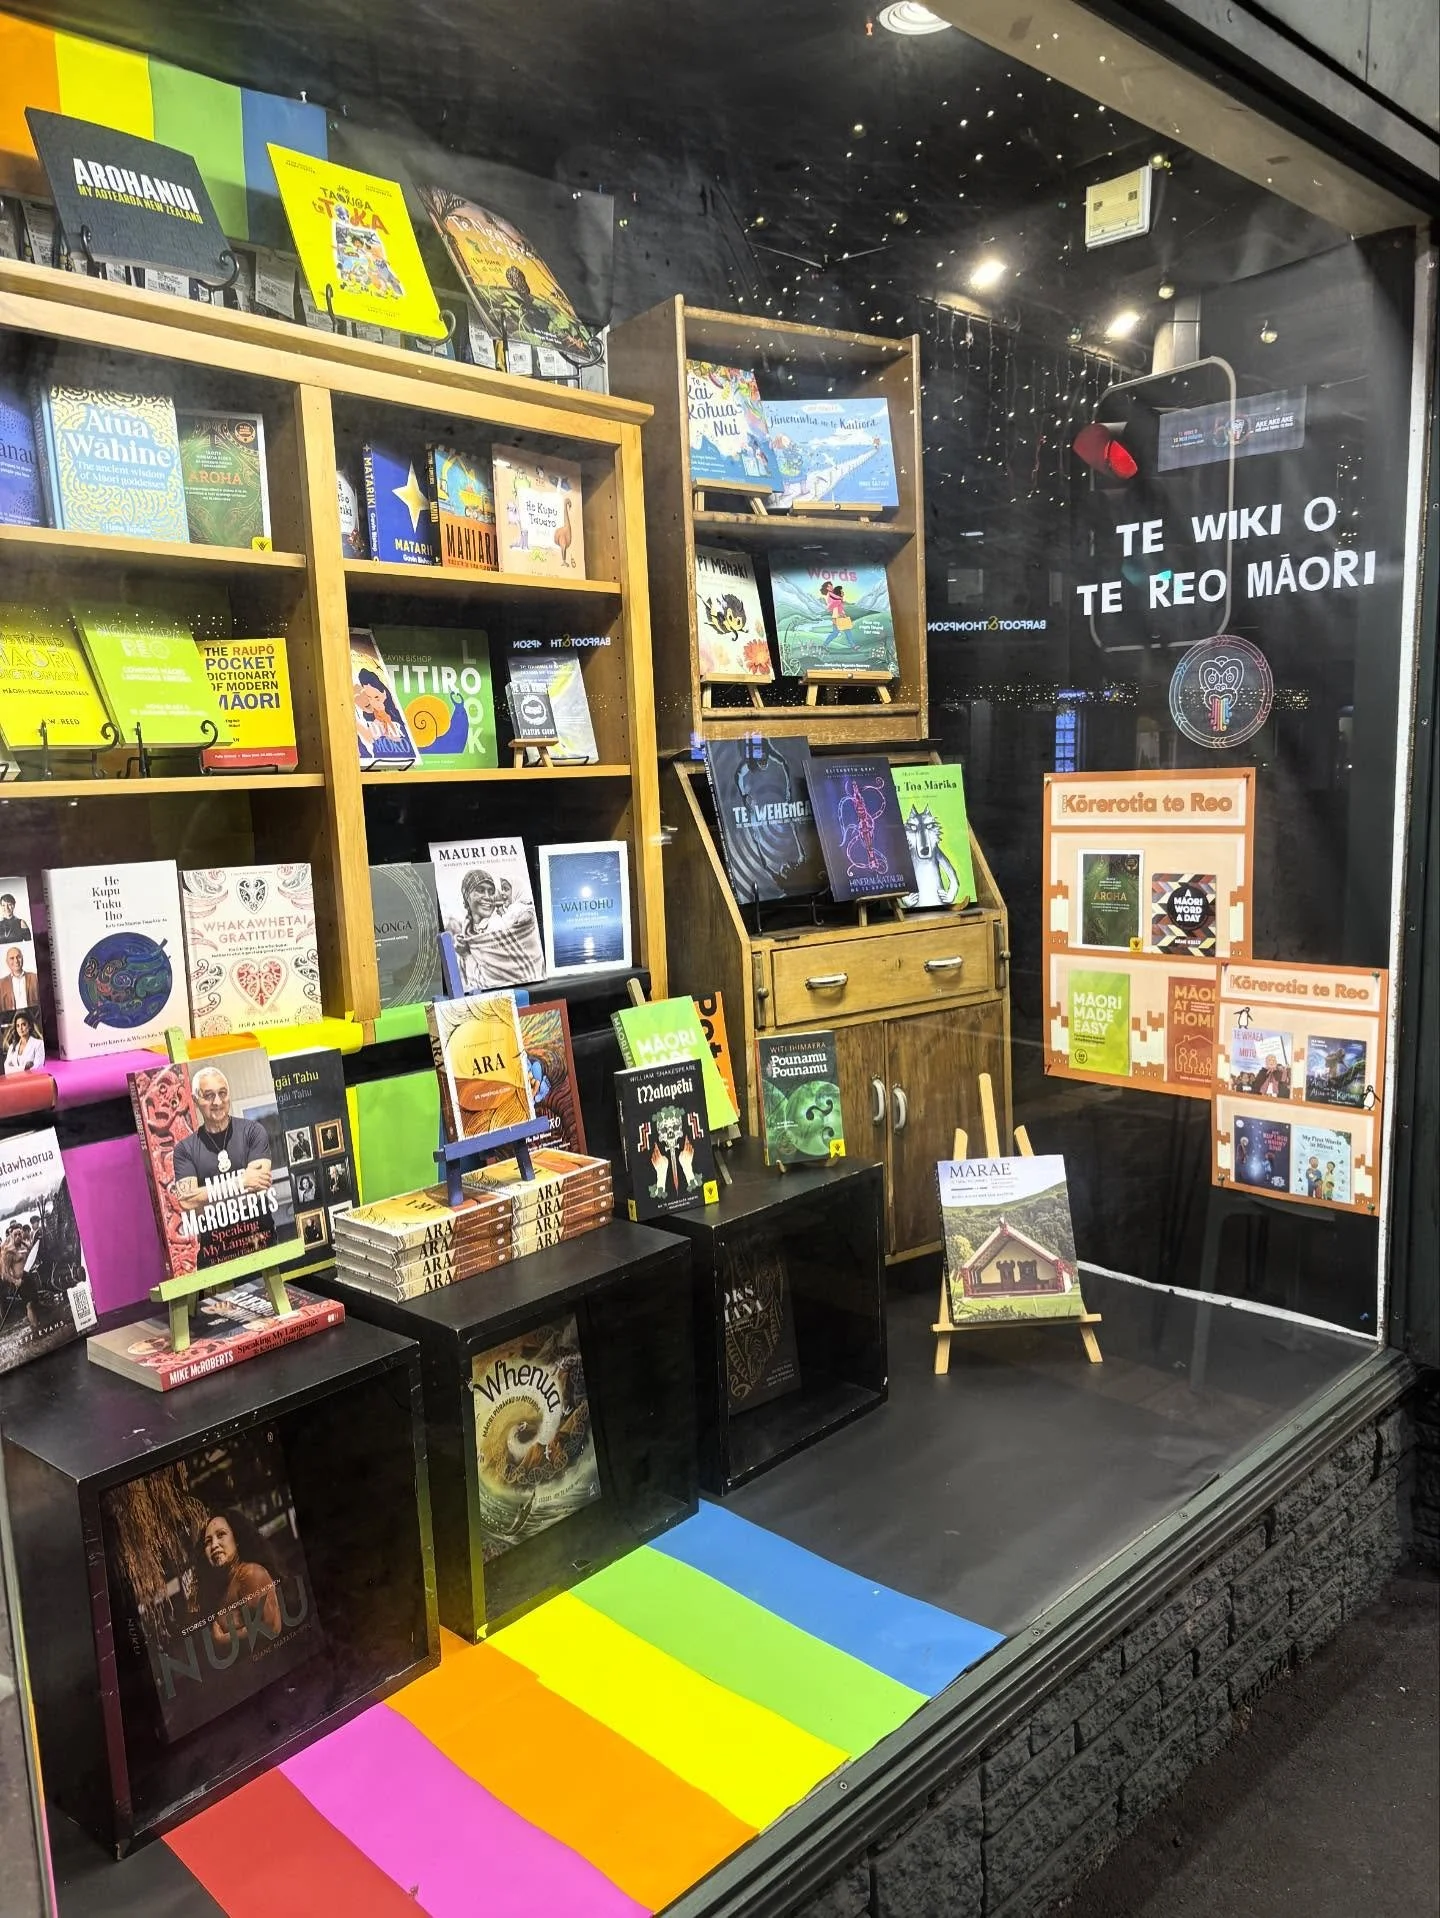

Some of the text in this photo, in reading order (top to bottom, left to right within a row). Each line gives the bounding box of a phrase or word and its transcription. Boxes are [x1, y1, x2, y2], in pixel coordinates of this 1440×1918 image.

[73, 158, 200, 214] AROHANUI
[78, 185, 203, 225] MY AOTEAROA NEW ZEALAND
[447, 215, 471, 233] Te
[691, 377, 701, 386] Te
[687, 401, 738, 420] Kōhua
[86, 407, 149, 440] Atua
[714, 418, 741, 437] Nui
[1268, 418, 1281, 426] AKE
[1280, 415, 1294, 424] AKE
[64, 432, 173, 468] Wāhine
[79, 461, 166, 479] The ancient wisdom
[80, 471, 91, 481] of
[187, 469, 243, 486] AROHA
[363, 457, 377, 510] MATARIKI
[526, 500, 558, 518] He Kupu
[1116, 496, 1337, 556] TE WIKI O
[402, 553, 419, 564] Gavin
[807, 567, 858, 582] Words
[1076, 550, 1376, 616] TE REO MĀORI
[204, 643, 275, 657] THE RAUPŌ
[205, 656, 275, 671] POCKET
[406, 655, 433, 663] BISHOP
[206, 670, 277, 681] DICTIONARY
[387, 665, 482, 695] TITIRO
[226, 680, 279, 692] MODERN
[60, 718, 80, 726] REED
[375, 737, 412, 754] MOKO
[905, 781, 922, 792] Toa
[1063, 791, 1233, 813] Kōrerotia te Reo
[732, 807, 749, 823] TE
[439, 845, 518, 861] MAURI ORA
[104, 875, 120, 887] He
[92, 886, 121, 898] Kupu
[1093, 891, 1128, 901] AROHA
[1184, 889, 1192, 898] A
[92, 899, 122, 910] Tuku
[560, 899, 614, 913] WAITOHU
[1173, 896, 1203, 906] MĀORI
[105, 910, 123, 921] Iho
[1174, 905, 1203, 915] WORD
[1176, 912, 1202, 923] A DAY
[203, 914, 307, 933] WHAKAWHETAI
[218, 928, 295, 944] GRATITUDE
[1230, 974, 1370, 1001] Kōrerotia te Reo
[1073, 991, 1122, 1010] MĀORI
[1174, 1000, 1189, 1011] AT
[258, 1017, 291, 1027] NATHAN
[1073, 1006, 1114, 1023] MADE
[1073, 1019, 1109, 1036] EASY
[1233, 1029, 1242, 1039] TE
[636, 1027, 697, 1057] MĀORI
[769, 1041, 827, 1054] WITI IHIMAERA
[472, 1052, 506, 1077] ARA
[771, 1052, 828, 1067] Pounamu
[292, 1070, 320, 1087] Tahu
[629, 1064, 697, 1083] WILLIAM SHAKESPEARE
[772, 1064, 829, 1079] Pounamu
[292, 1088, 313, 1100] Tahu
[12, 1177, 20, 1186] OF
[26, 1169, 44, 1179] WAKA
[950, 1162, 1012, 1179] MARAE
[204, 1168, 249, 1203] MIKE
[537, 1181, 562, 1203] ARA
[180, 1186, 279, 1238] McROBERTS
[536, 1197, 561, 1219] ARA
[211, 1220, 260, 1242] Speaking
[424, 1219, 454, 1243] ARA
[535, 1213, 561, 1235] ARA
[203, 1230, 272, 1258] My Language
[536, 1229, 561, 1251] ARA
[419, 1237, 450, 1261] ARA
[423, 1252, 453, 1277] ARA
[424, 1269, 454, 1293] ARA
[37, 1320, 66, 1338] EVANS
[169, 1318, 319, 1386] MIKE McROBERTS Speaking My Language
[473, 1359, 561, 1413] Whenua
[482, 1415, 494, 1438] MĀORI
[181, 1579, 281, 1636] STORIES OF 100 INDIGENOUS WOMEN
[126, 1617, 142, 1656] NUKU
[156, 1576, 309, 1700] NUKU
